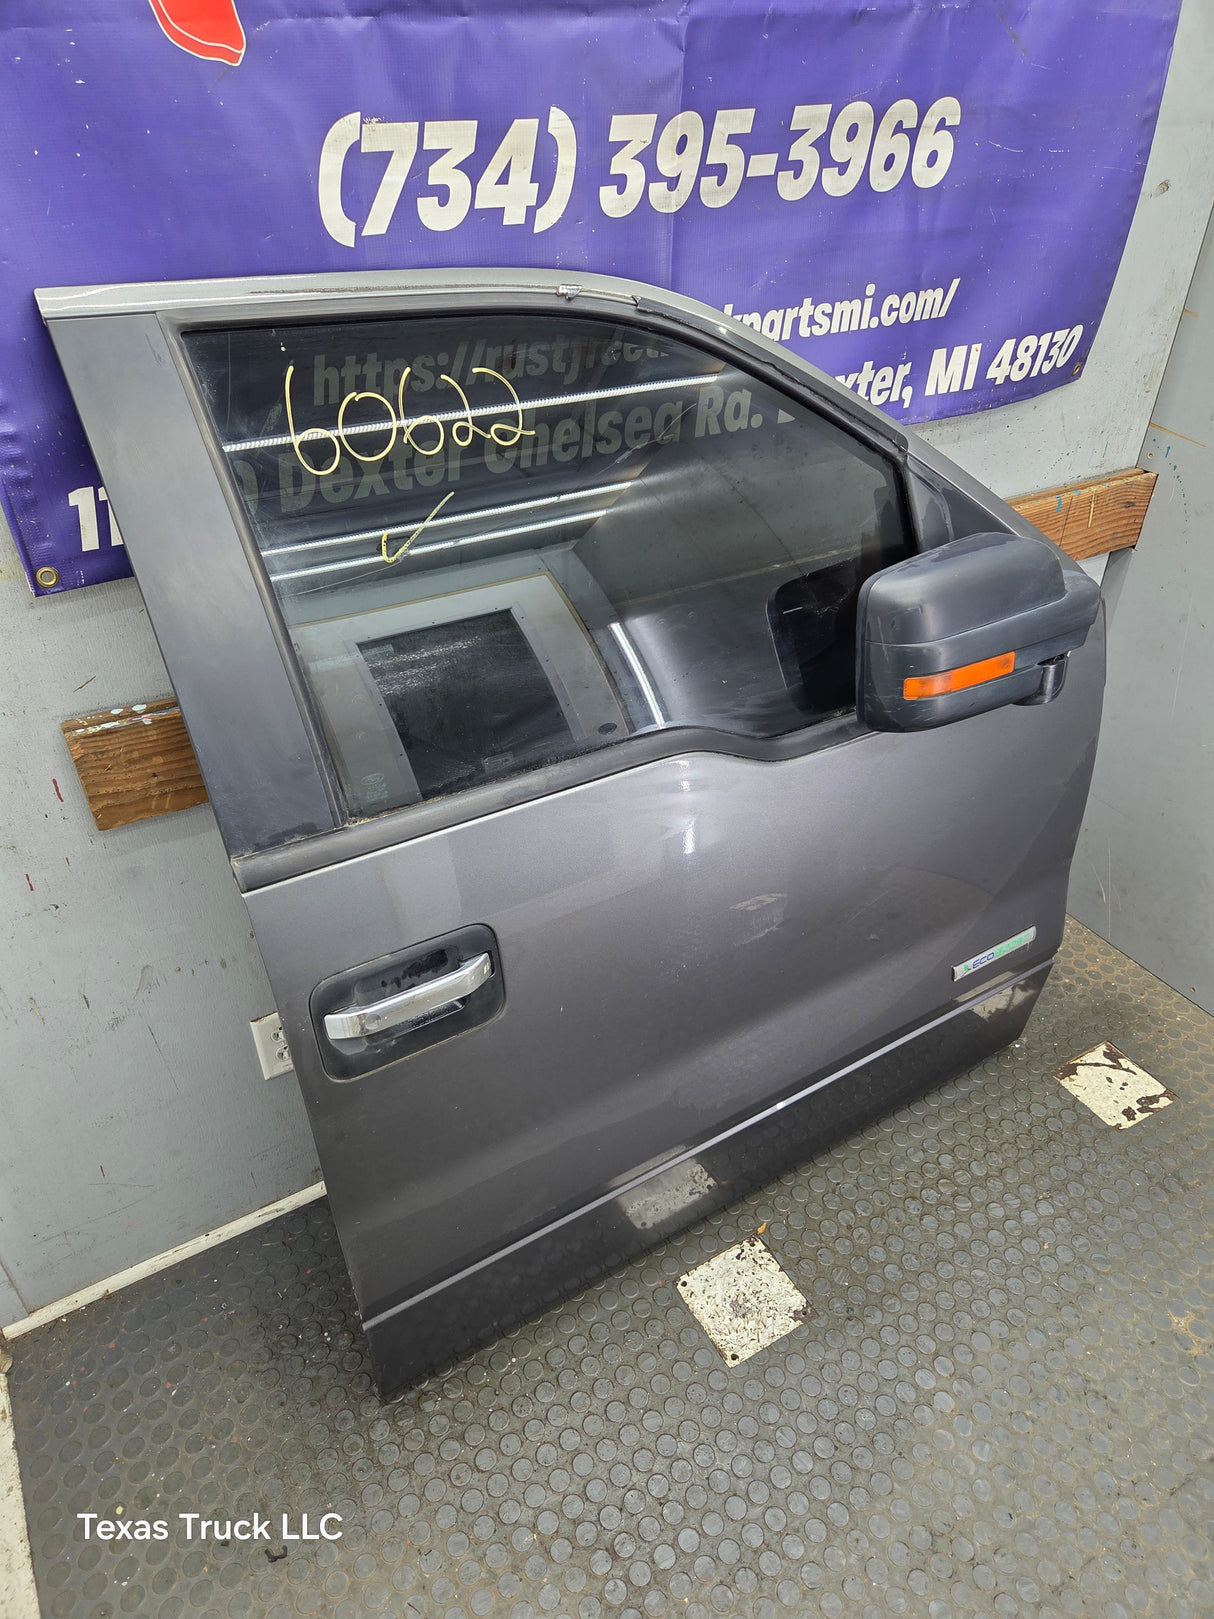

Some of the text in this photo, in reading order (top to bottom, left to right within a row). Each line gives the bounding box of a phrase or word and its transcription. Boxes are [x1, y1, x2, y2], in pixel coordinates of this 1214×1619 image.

[318, 96, 962, 248] (734) 395-3966
[278, 434, 467, 513] Dexter
[484, 399, 684, 474] Chelsea
[695, 386, 763, 438] Rd.
[925, 343, 982, 396] MI
[985, 323, 1084, 386] 48130
[285, 365, 536, 476] 60622
